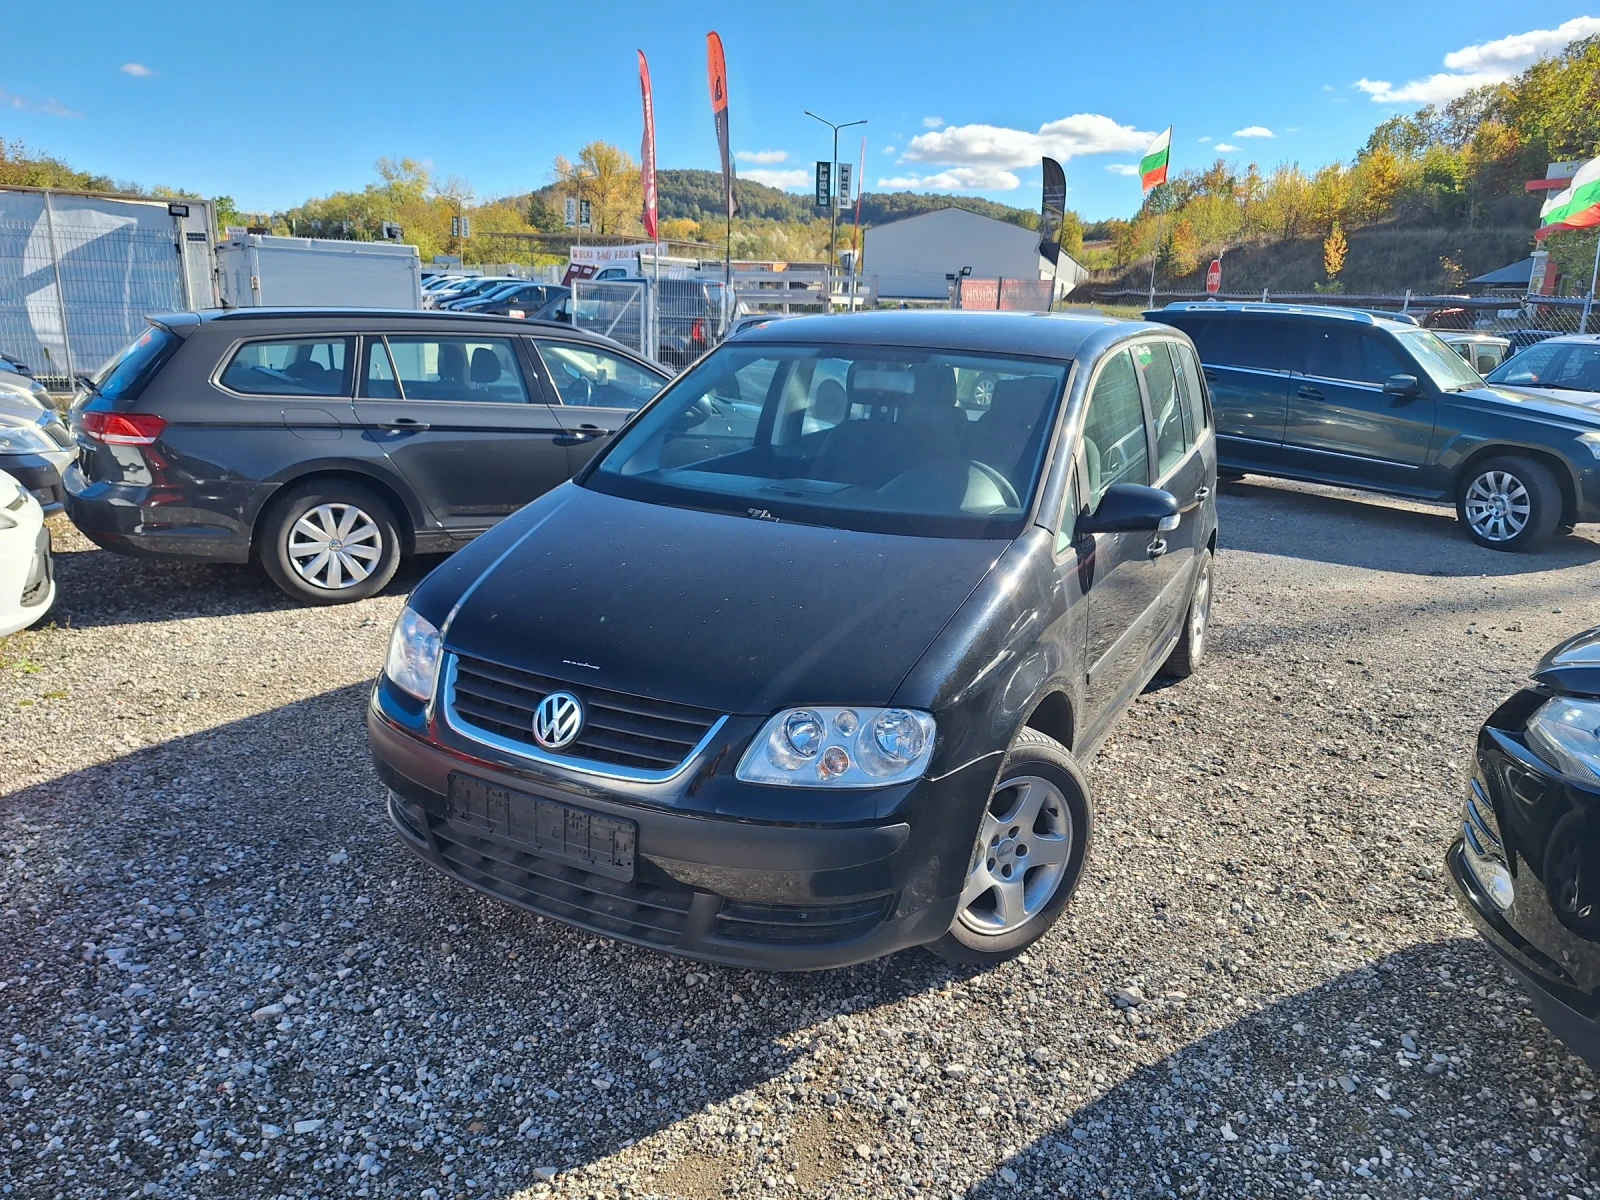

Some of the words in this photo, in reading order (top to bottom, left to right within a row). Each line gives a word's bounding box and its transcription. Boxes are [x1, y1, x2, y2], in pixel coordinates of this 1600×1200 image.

[819, 163, 828, 205] EFBET
[841, 166, 849, 206] EFBET
[1208, 272, 1219, 285] STOP
